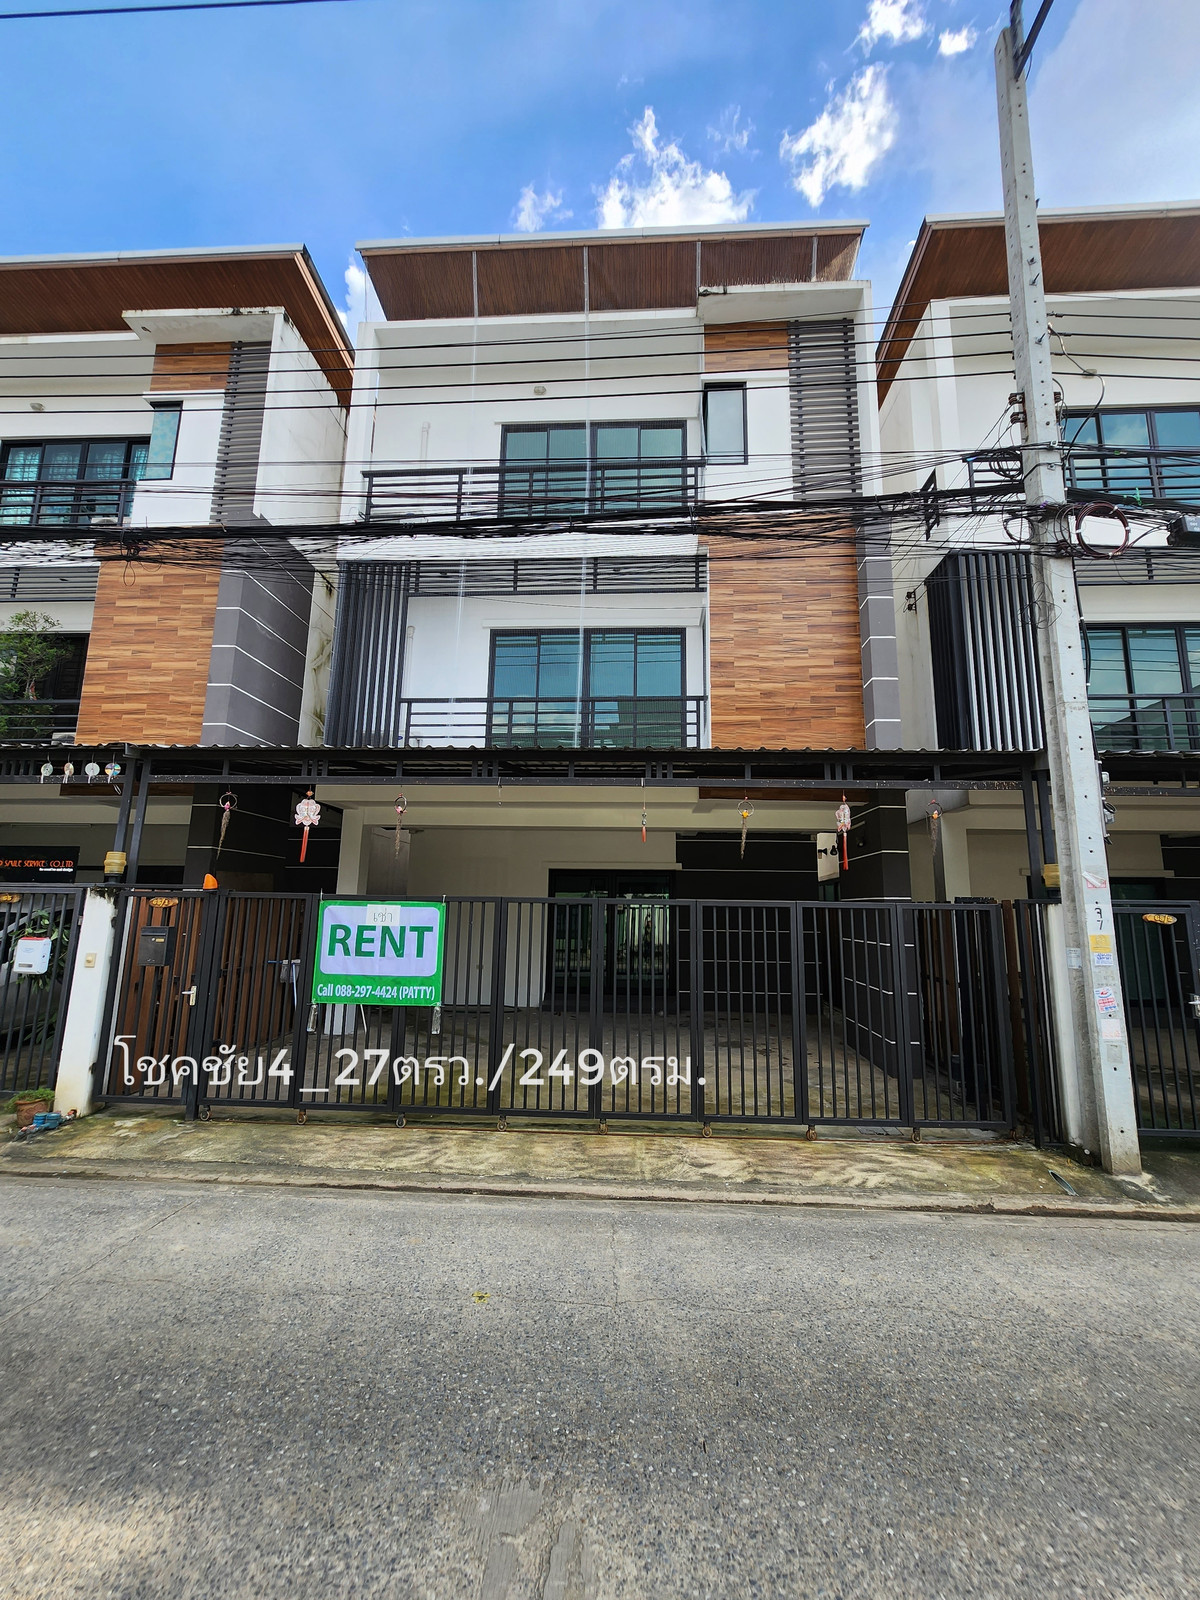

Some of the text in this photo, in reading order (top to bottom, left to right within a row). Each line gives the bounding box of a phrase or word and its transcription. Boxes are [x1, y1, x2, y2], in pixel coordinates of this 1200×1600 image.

[373, 907, 393, 923] เช่า
[327, 924, 434, 958] RENT
[317, 983, 435, 1000] Call 088-297-4424 (PATTY)
